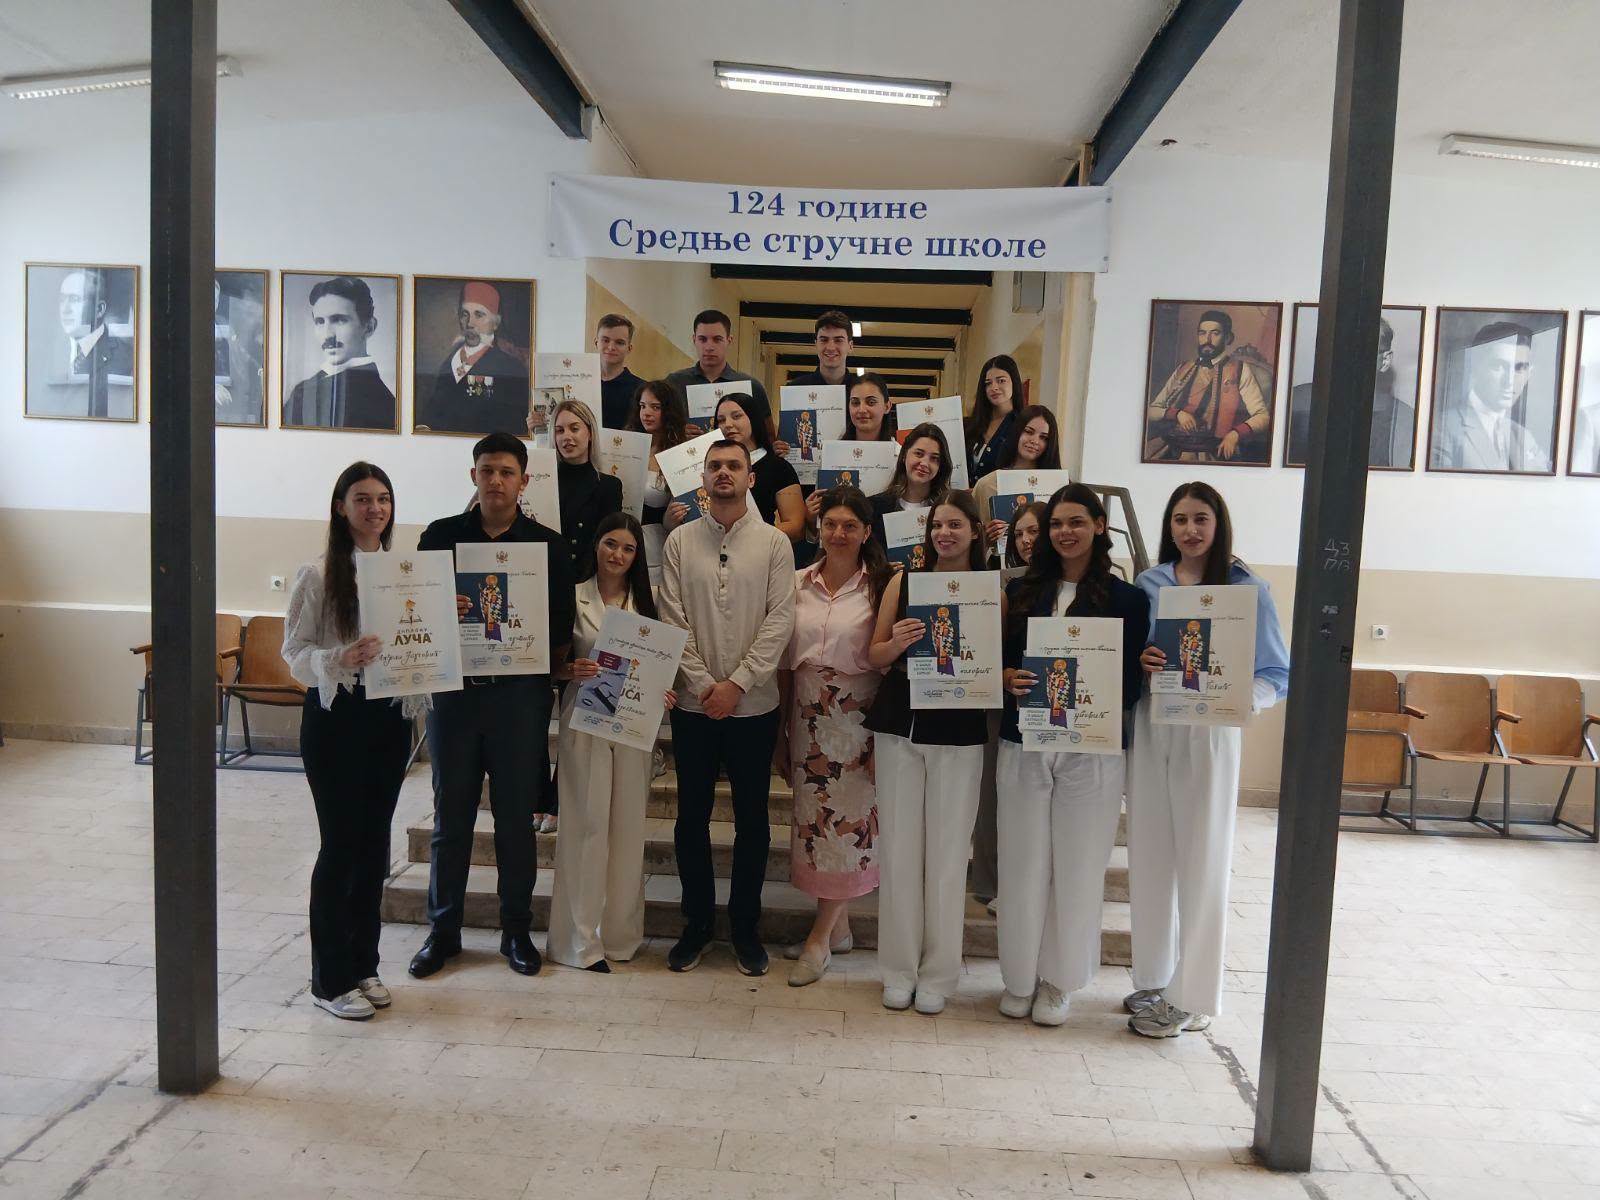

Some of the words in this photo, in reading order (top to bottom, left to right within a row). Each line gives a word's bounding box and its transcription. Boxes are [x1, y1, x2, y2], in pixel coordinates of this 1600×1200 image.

[728, 190, 786, 216] 124
[798, 199, 928, 222] године
[608, 217, 752, 256] Средње
[762, 231, 913, 261] стручне
[924, 235, 1047, 259] школе
